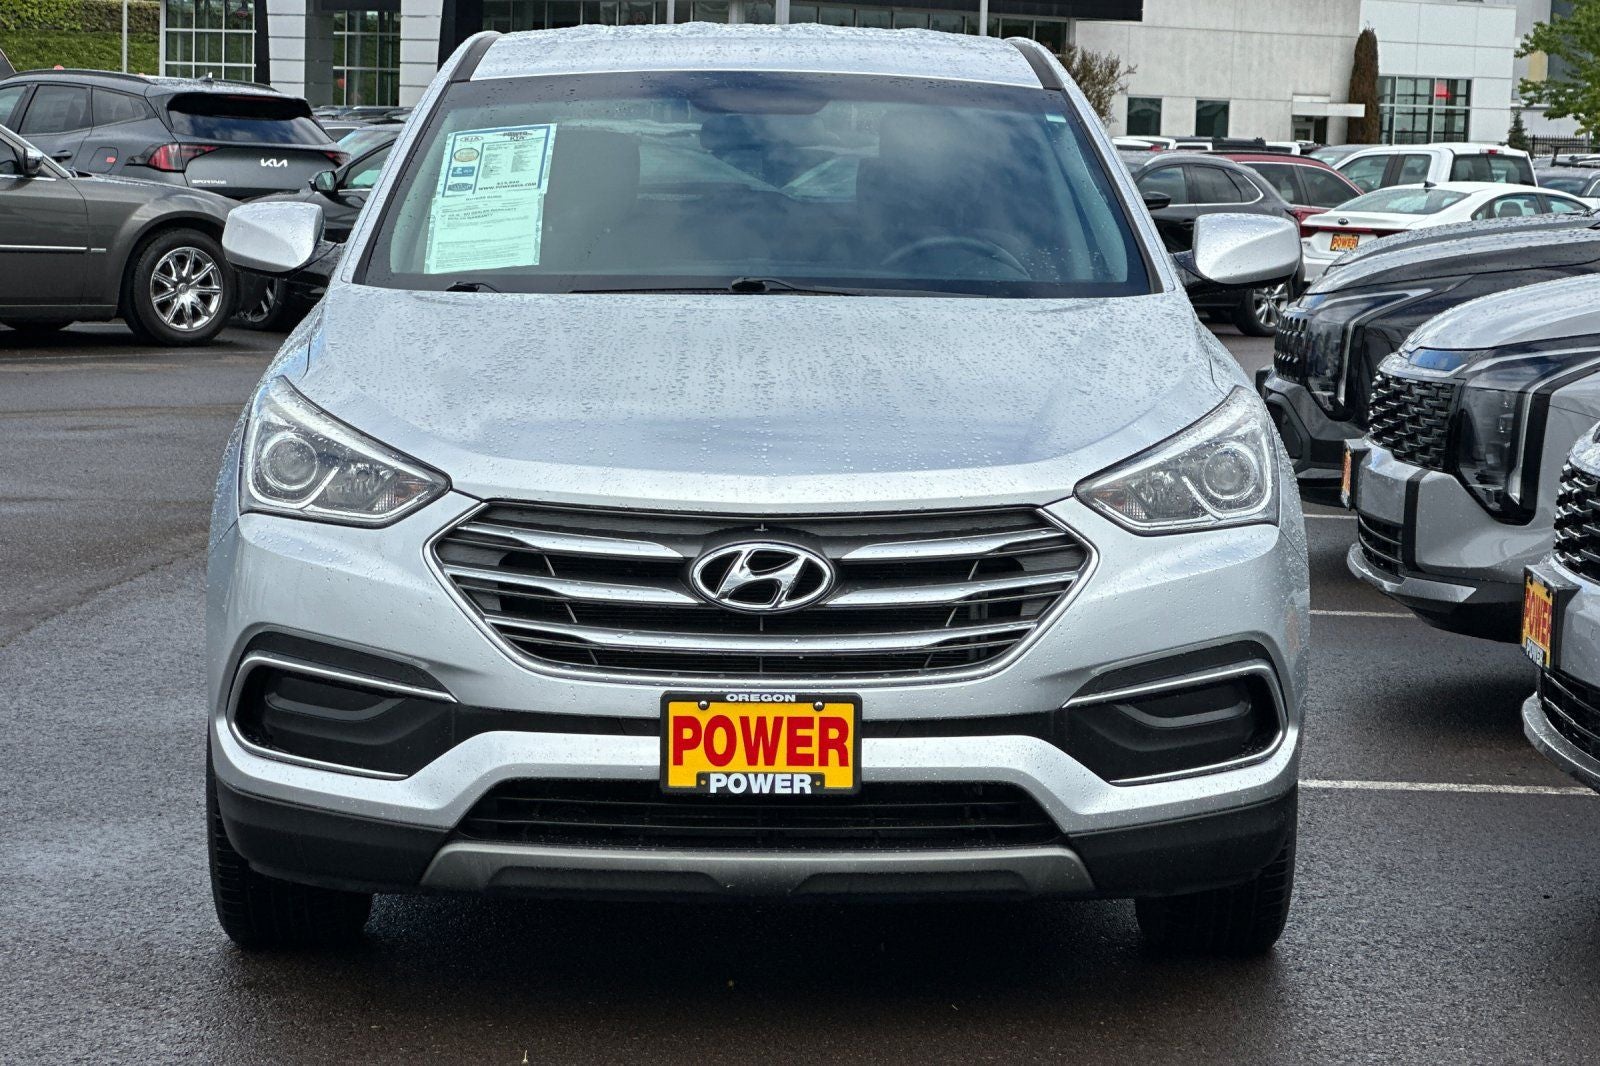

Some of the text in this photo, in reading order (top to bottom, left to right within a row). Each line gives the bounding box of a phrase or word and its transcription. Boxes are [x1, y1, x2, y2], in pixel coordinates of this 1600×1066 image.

[260, 158, 288, 168] KIA
[1332, 235, 1357, 248] POWER
[725, 693, 796, 703] OREGON
[672, 714, 850, 767] POWER
[709, 773, 812, 795] POWER
